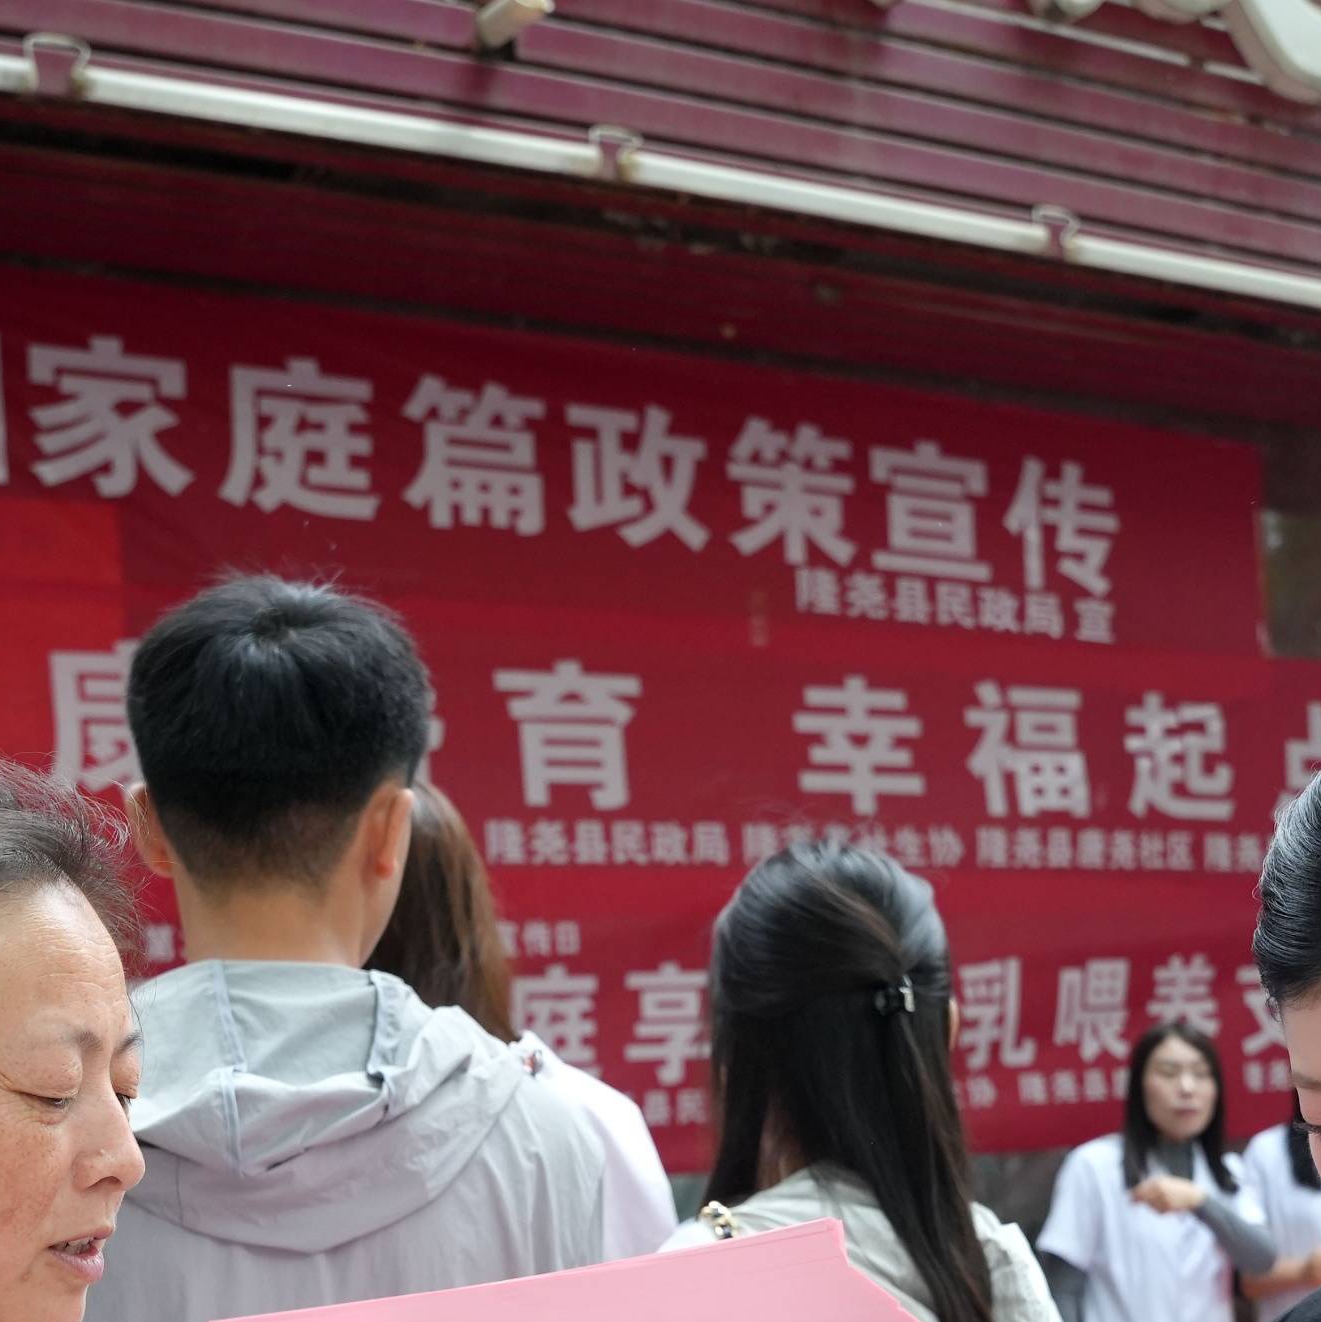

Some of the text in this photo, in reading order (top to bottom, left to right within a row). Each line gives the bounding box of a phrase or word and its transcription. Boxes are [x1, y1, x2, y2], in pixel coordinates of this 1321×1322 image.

[795, 564, 1066, 641] 隆尧县民政局
[484, 816, 731, 866] 隆尧县民政局
